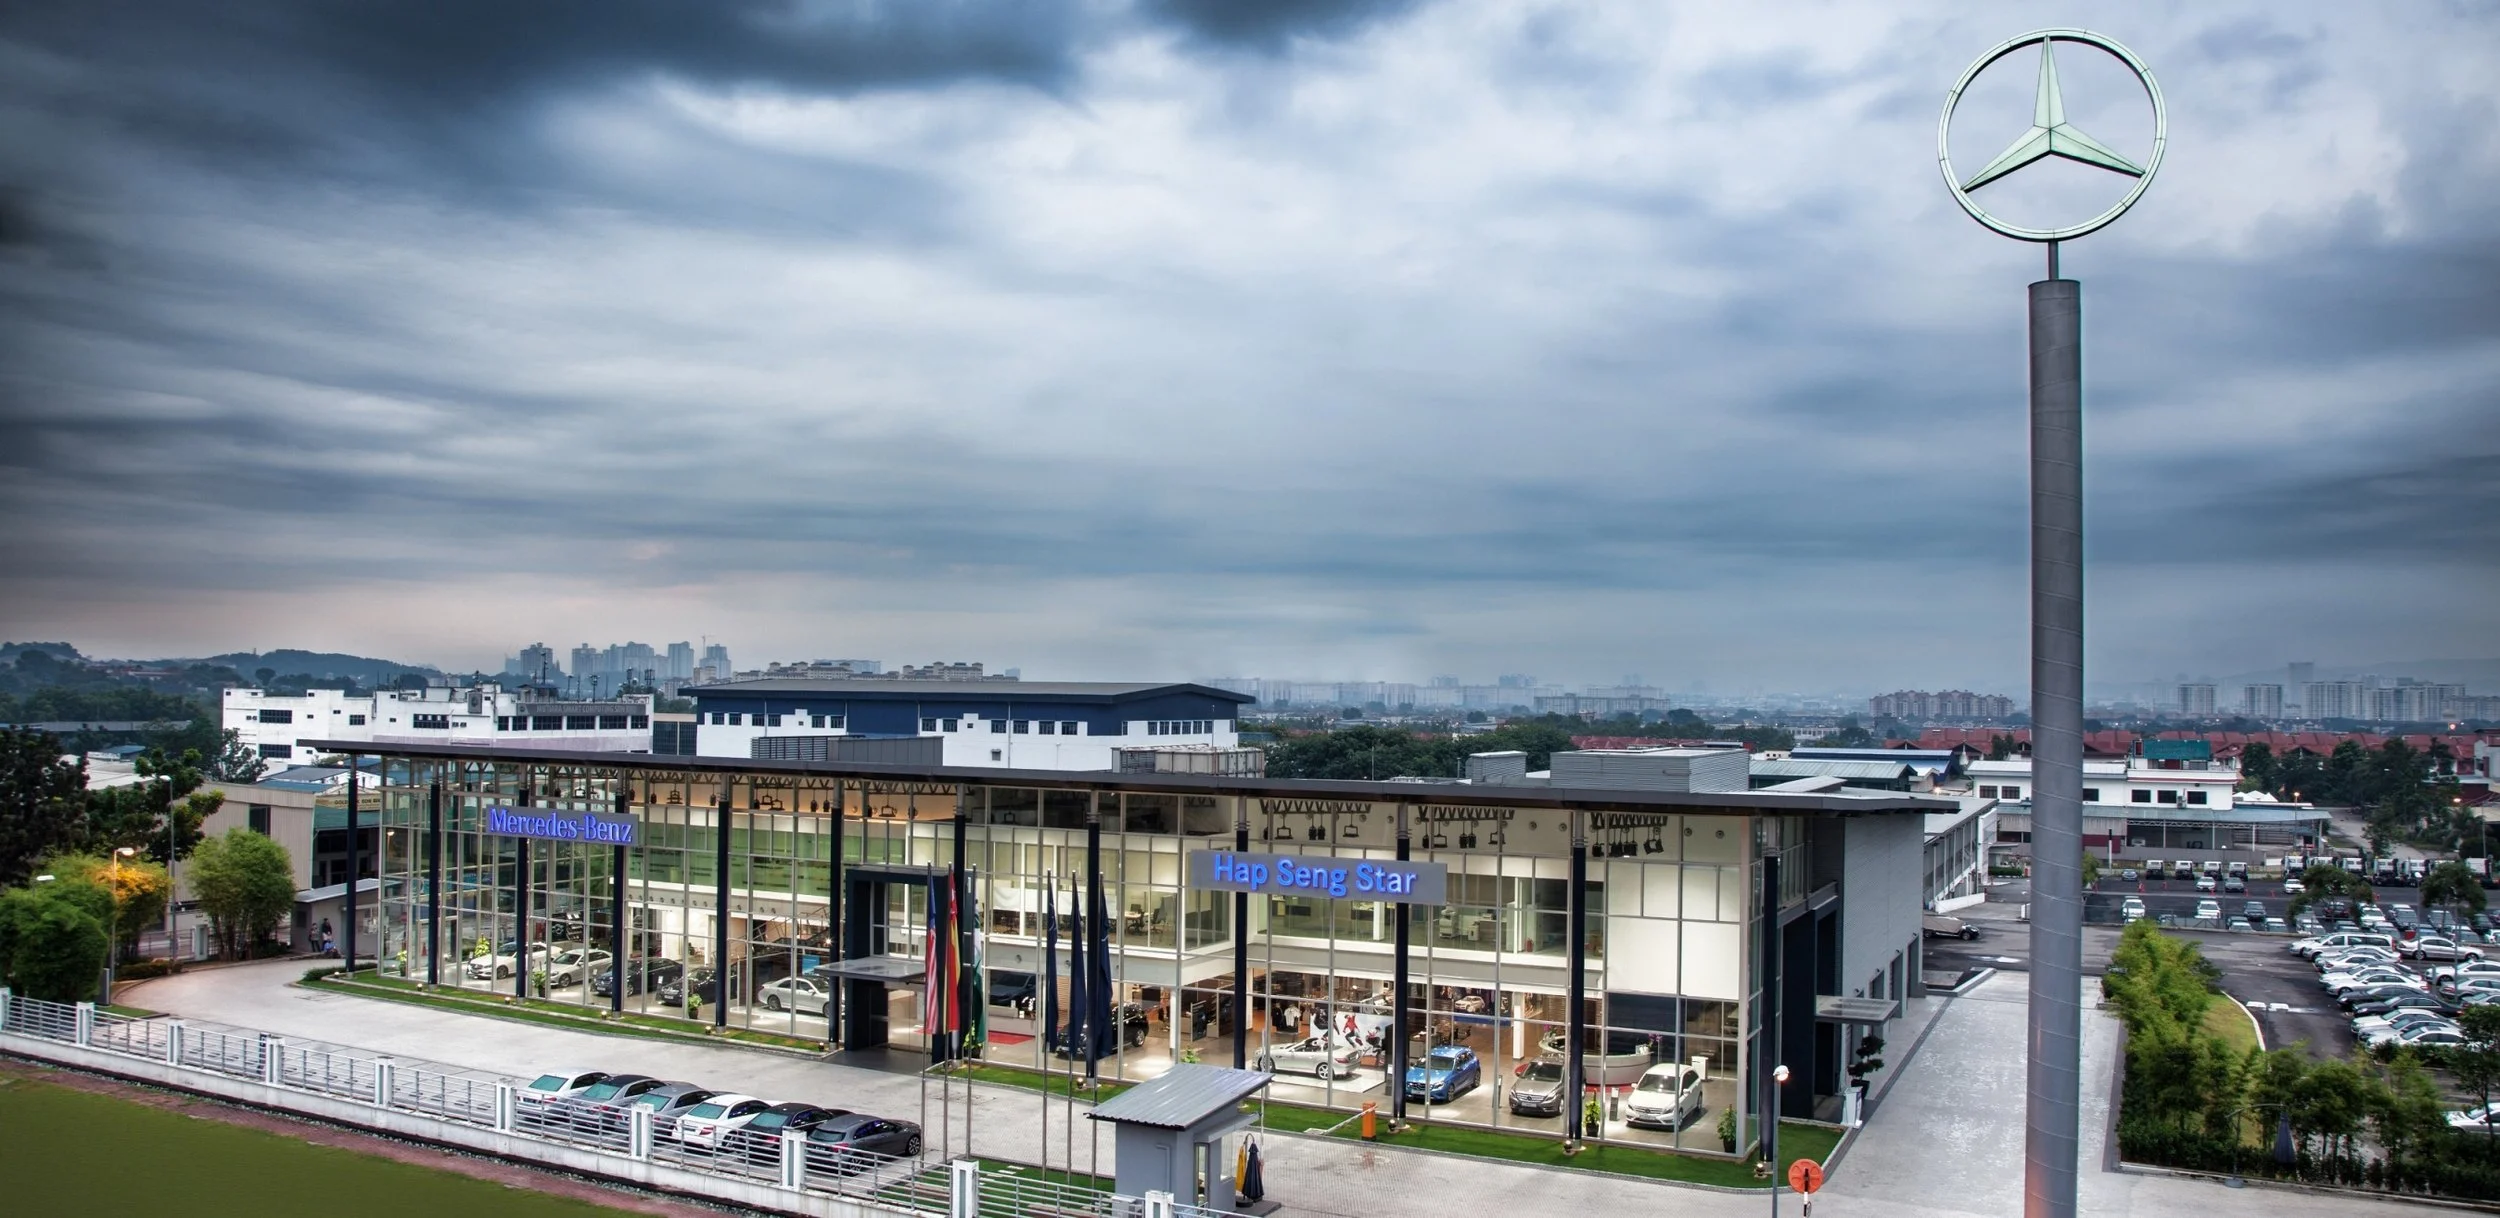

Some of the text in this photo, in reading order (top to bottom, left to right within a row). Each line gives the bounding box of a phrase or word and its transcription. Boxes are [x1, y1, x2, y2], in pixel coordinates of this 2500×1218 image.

[490, 808, 633, 843] Mercedes-Benz
[1214, 854, 1417, 898] Hap Seng Star
